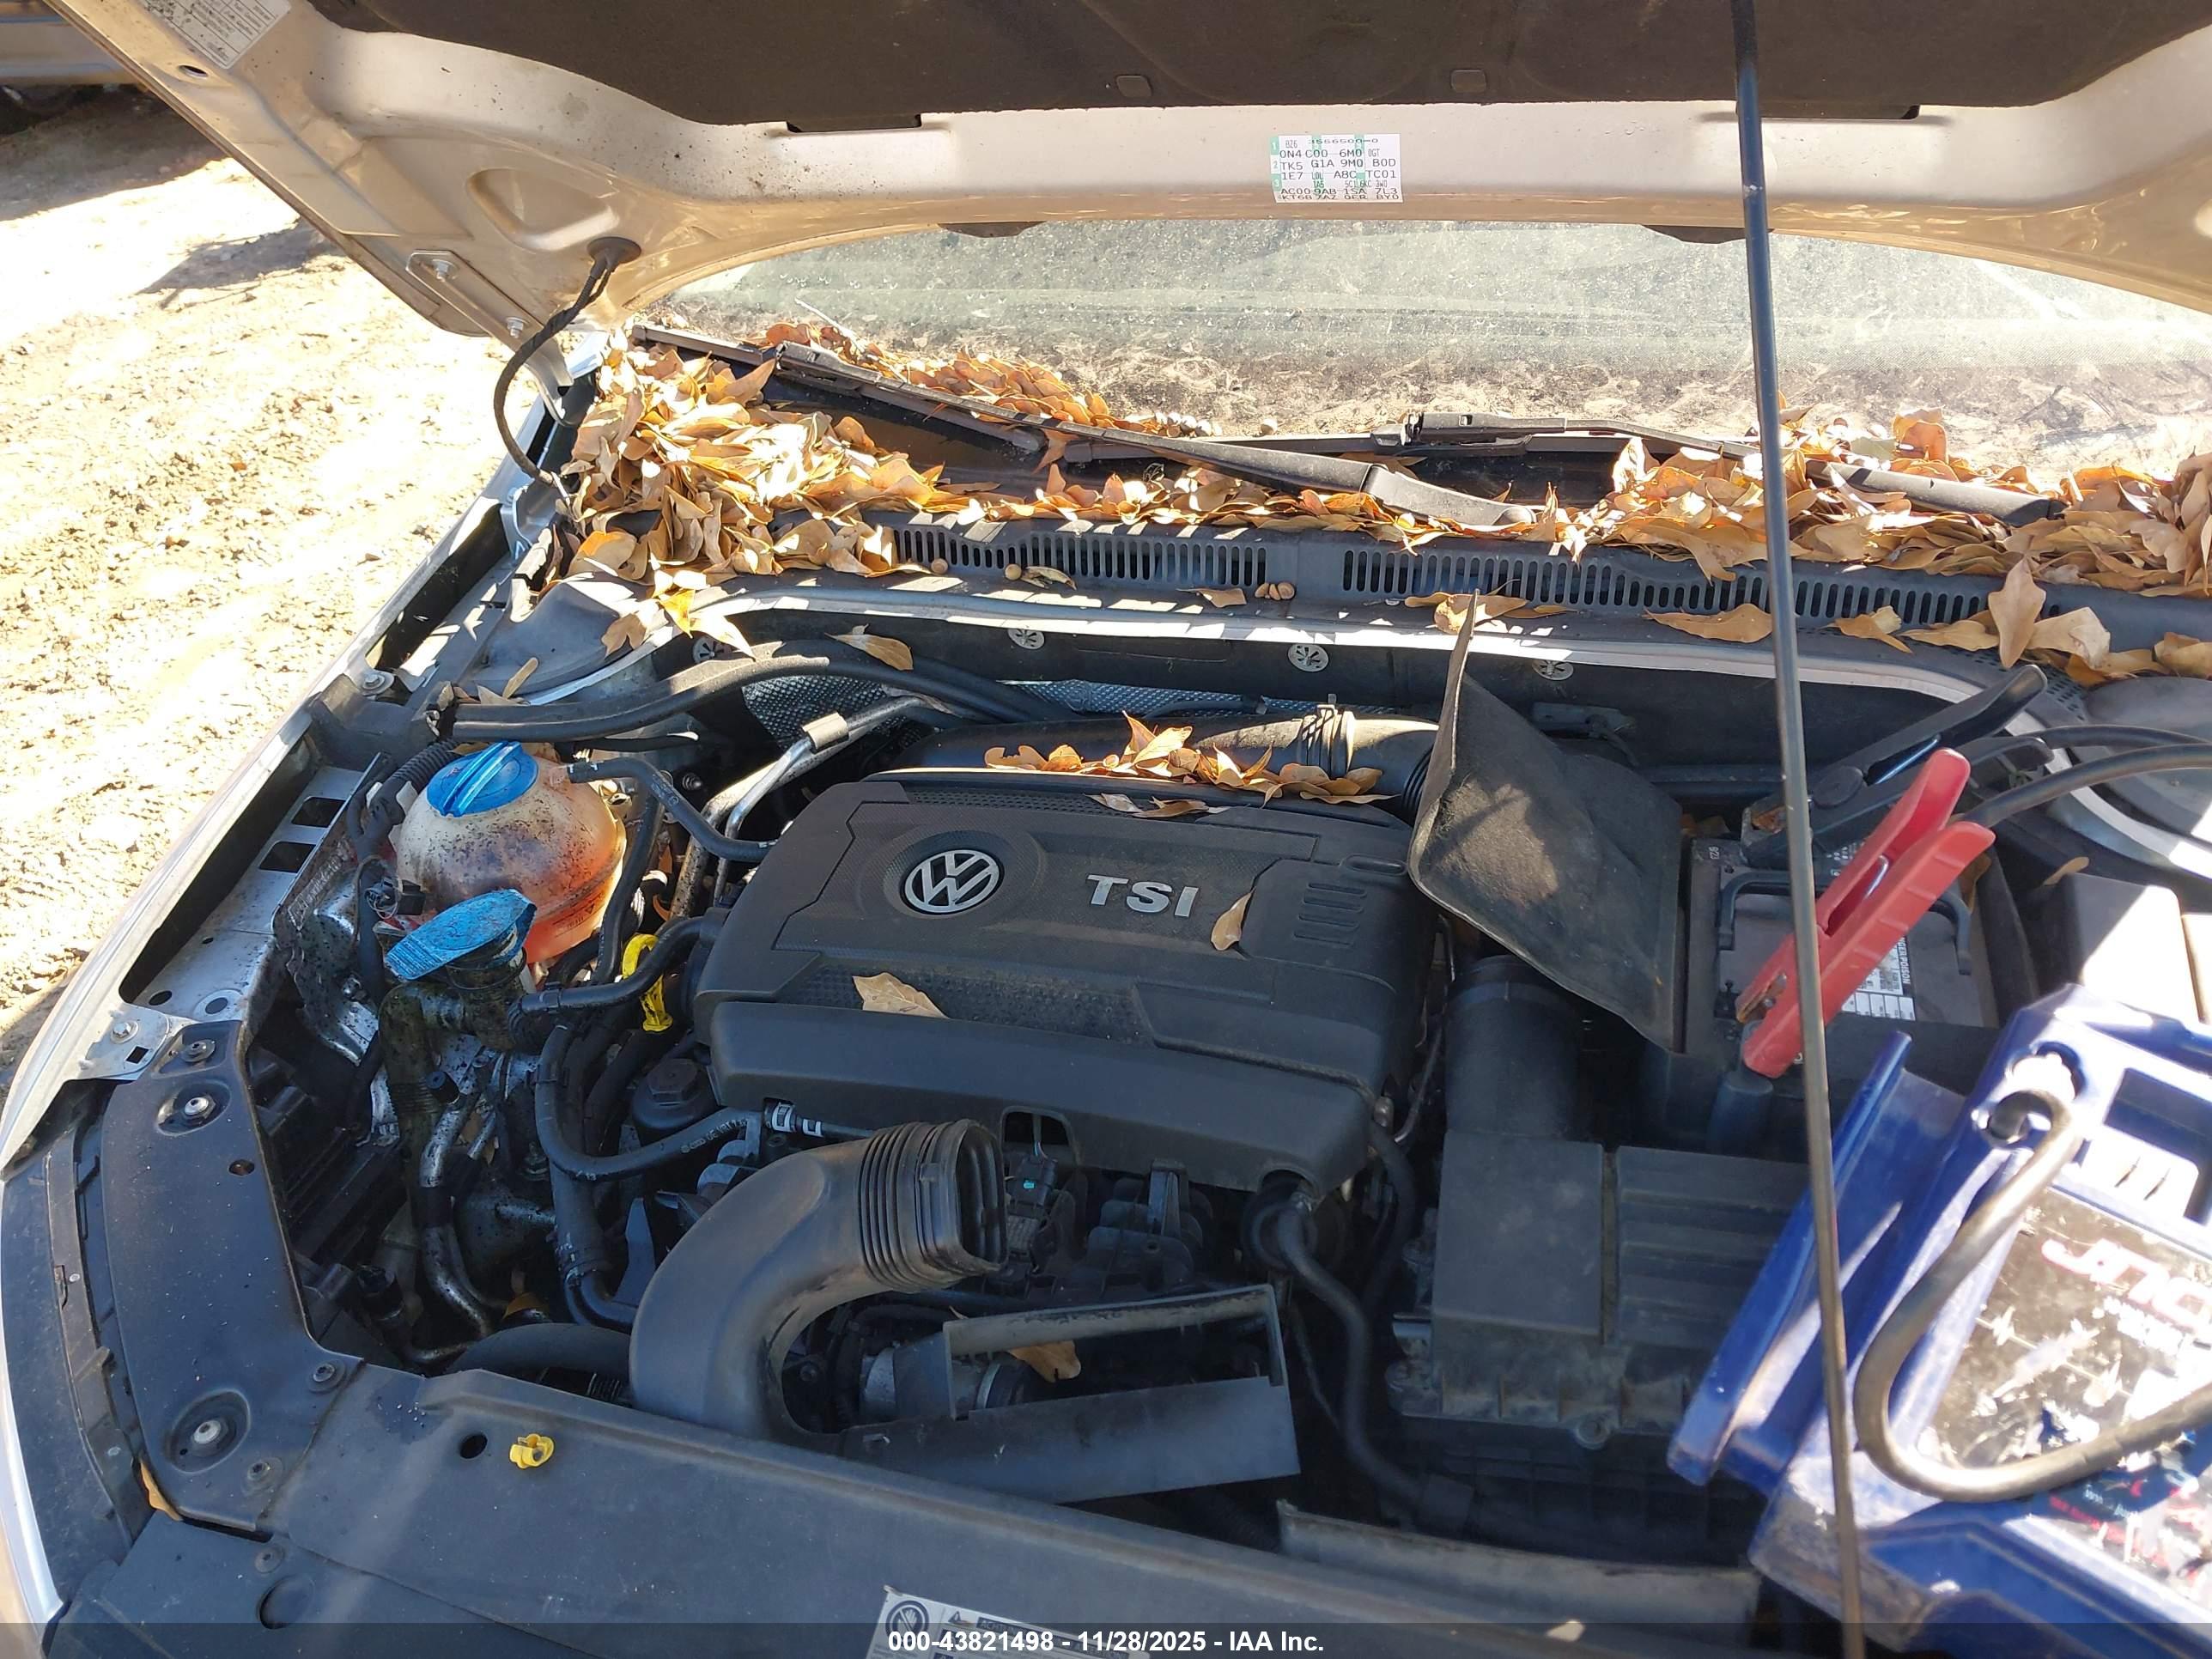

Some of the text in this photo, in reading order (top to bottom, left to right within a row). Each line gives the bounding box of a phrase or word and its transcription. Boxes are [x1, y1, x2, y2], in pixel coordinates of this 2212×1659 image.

[1279, 161, 1304, 171] TK5
[1282, 172, 1304, 180] 1E7
[1086, 874, 1199, 917] TSI
